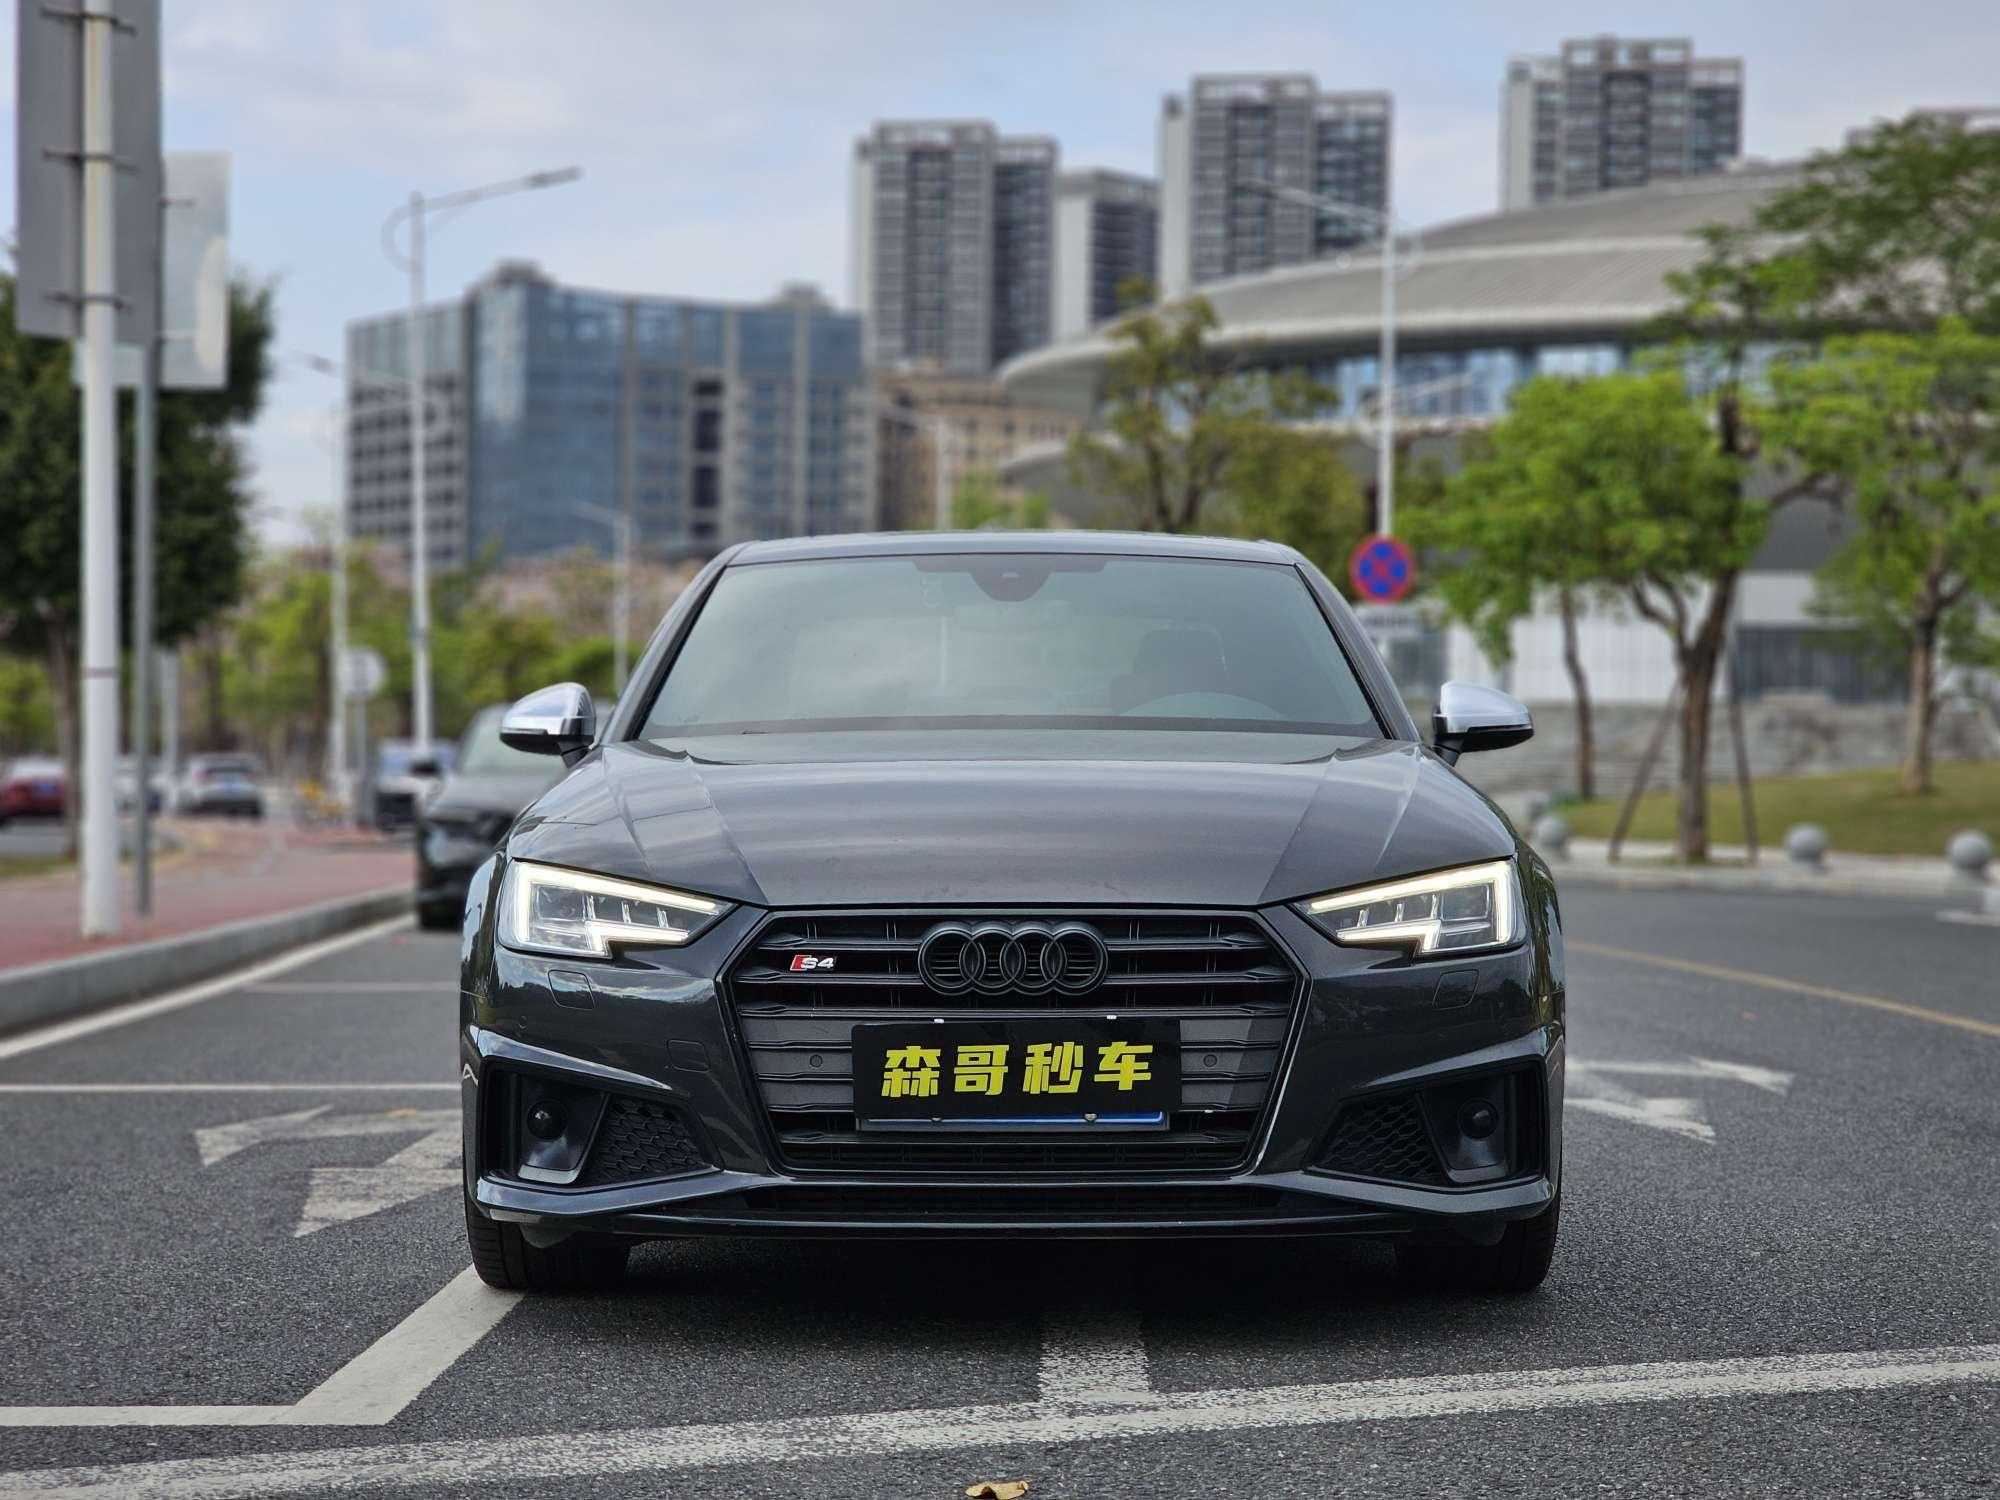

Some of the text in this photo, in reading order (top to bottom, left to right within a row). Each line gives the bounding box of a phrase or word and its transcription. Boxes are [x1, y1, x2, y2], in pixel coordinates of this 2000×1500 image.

[799, 956, 835, 970] S4
[881, 1041, 1153, 1098] 森哥秒车
